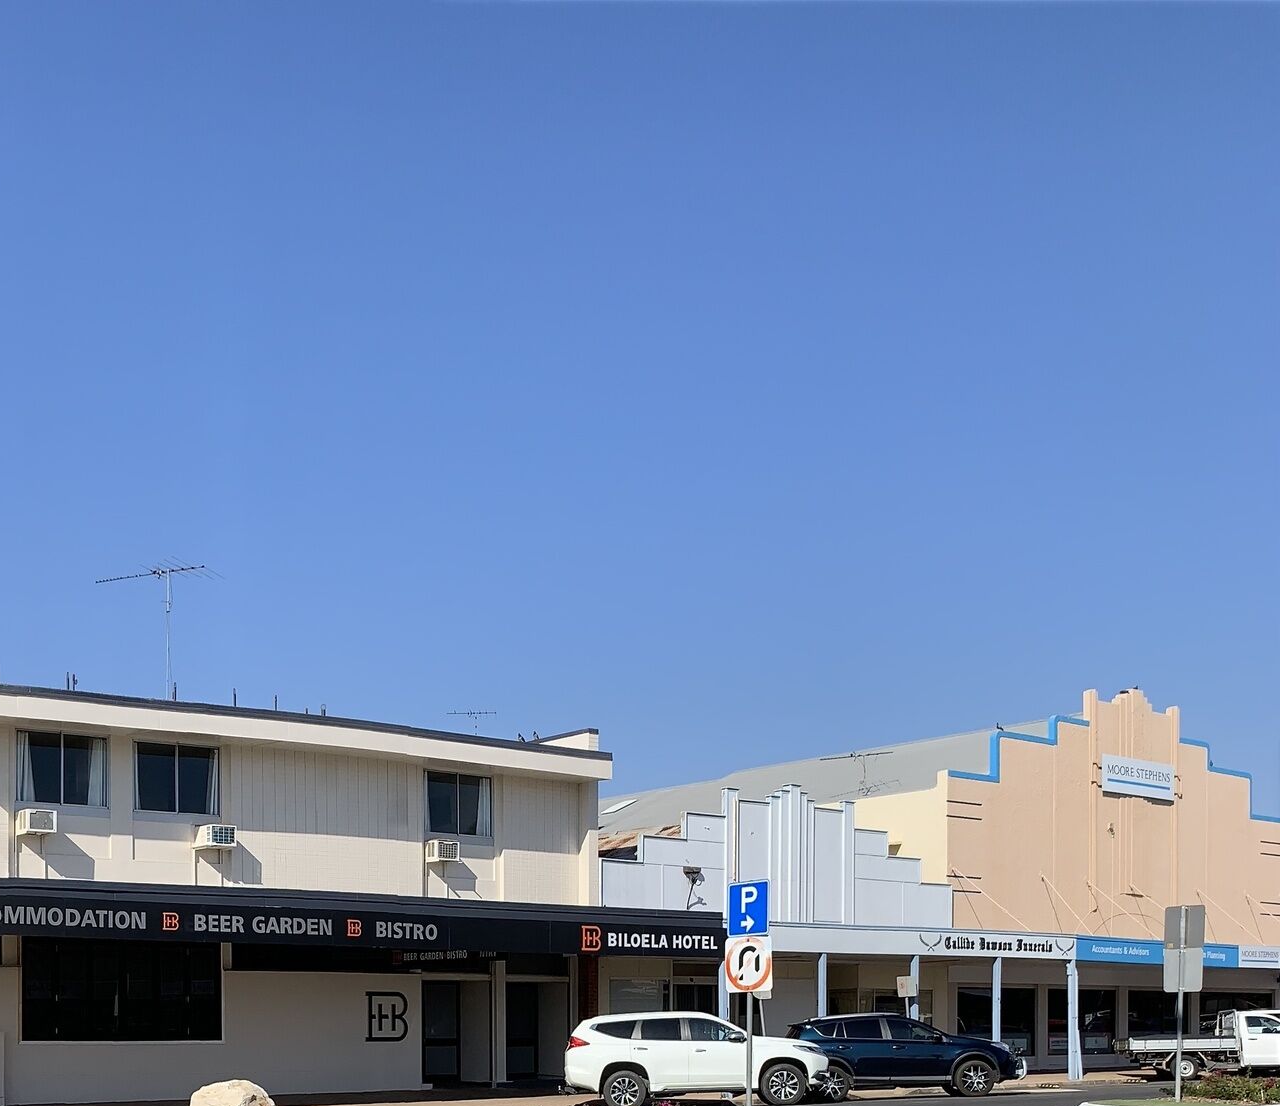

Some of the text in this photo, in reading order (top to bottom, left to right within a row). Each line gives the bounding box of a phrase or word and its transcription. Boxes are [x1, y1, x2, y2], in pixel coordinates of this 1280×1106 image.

[1107, 764, 1171, 783] MOORE STEPHENS
[741, 886, 758, 914] P
[193, 913, 245, 934] BEER
[252, 915, 333, 936] GARDEN
[375, 921, 438, 941] BISTRO
[607, 932, 669, 949] BILOELA
[672, 934, 718, 950] HOTEL
[979, 937, 1013, 951] Dawson
[1016, 938, 1053, 953] Funerals
[403, 950, 468, 961] BEER GARDEN BISTRO
[1091, 944, 1150, 957] Accountants & Advisors
